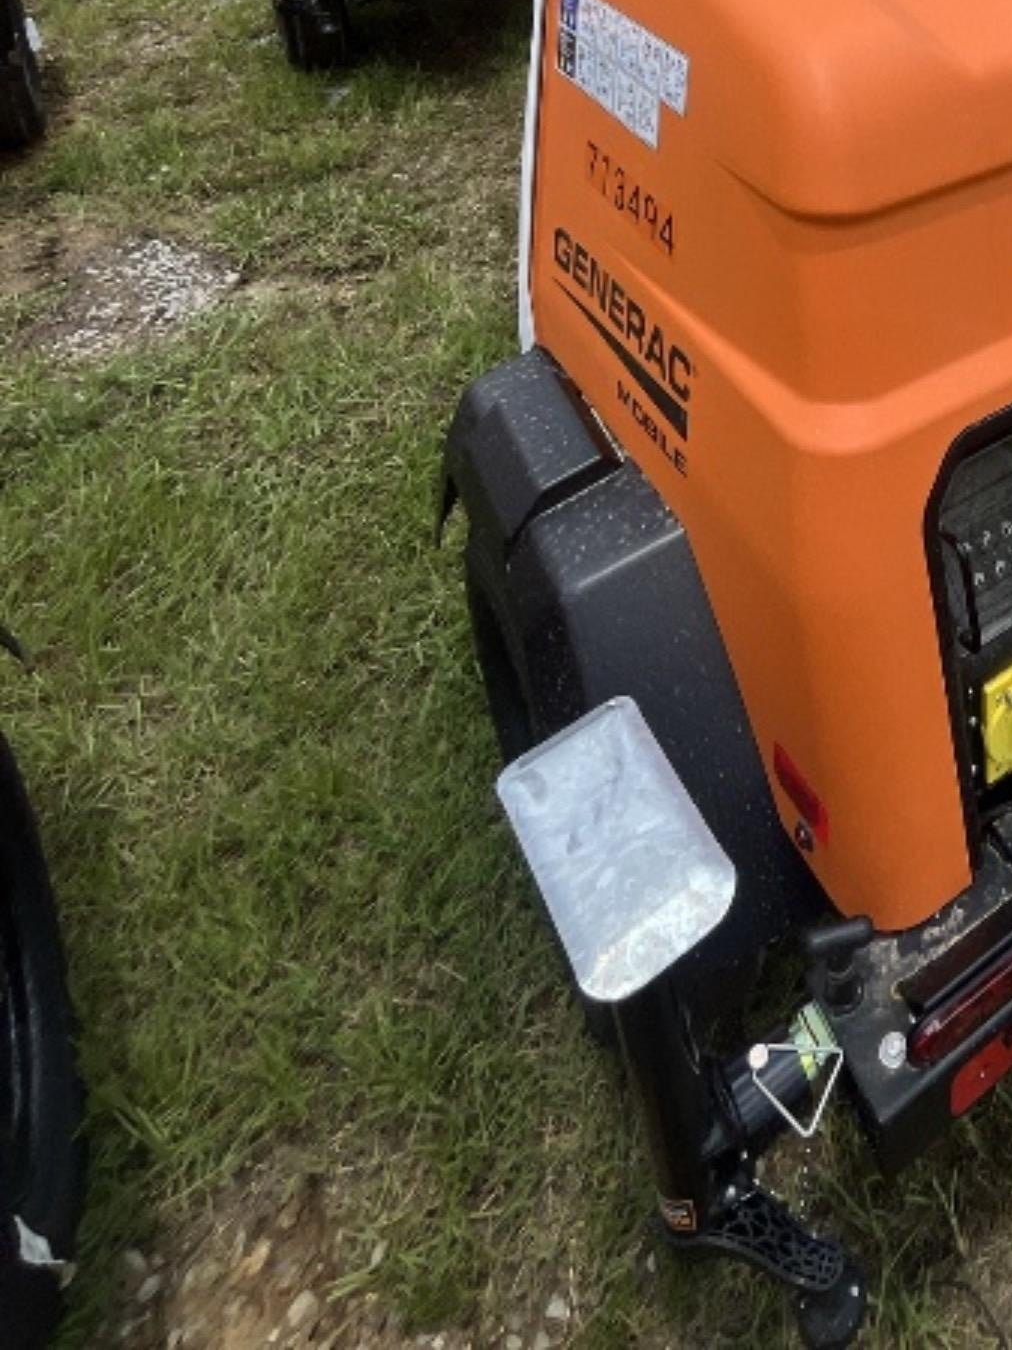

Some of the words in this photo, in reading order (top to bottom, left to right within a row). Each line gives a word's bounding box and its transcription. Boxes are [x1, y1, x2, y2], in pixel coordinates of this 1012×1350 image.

[586, 140, 676, 257] 713494
[552, 226, 693, 403] GENERAC
[617, 379, 688, 479] MOBILE
